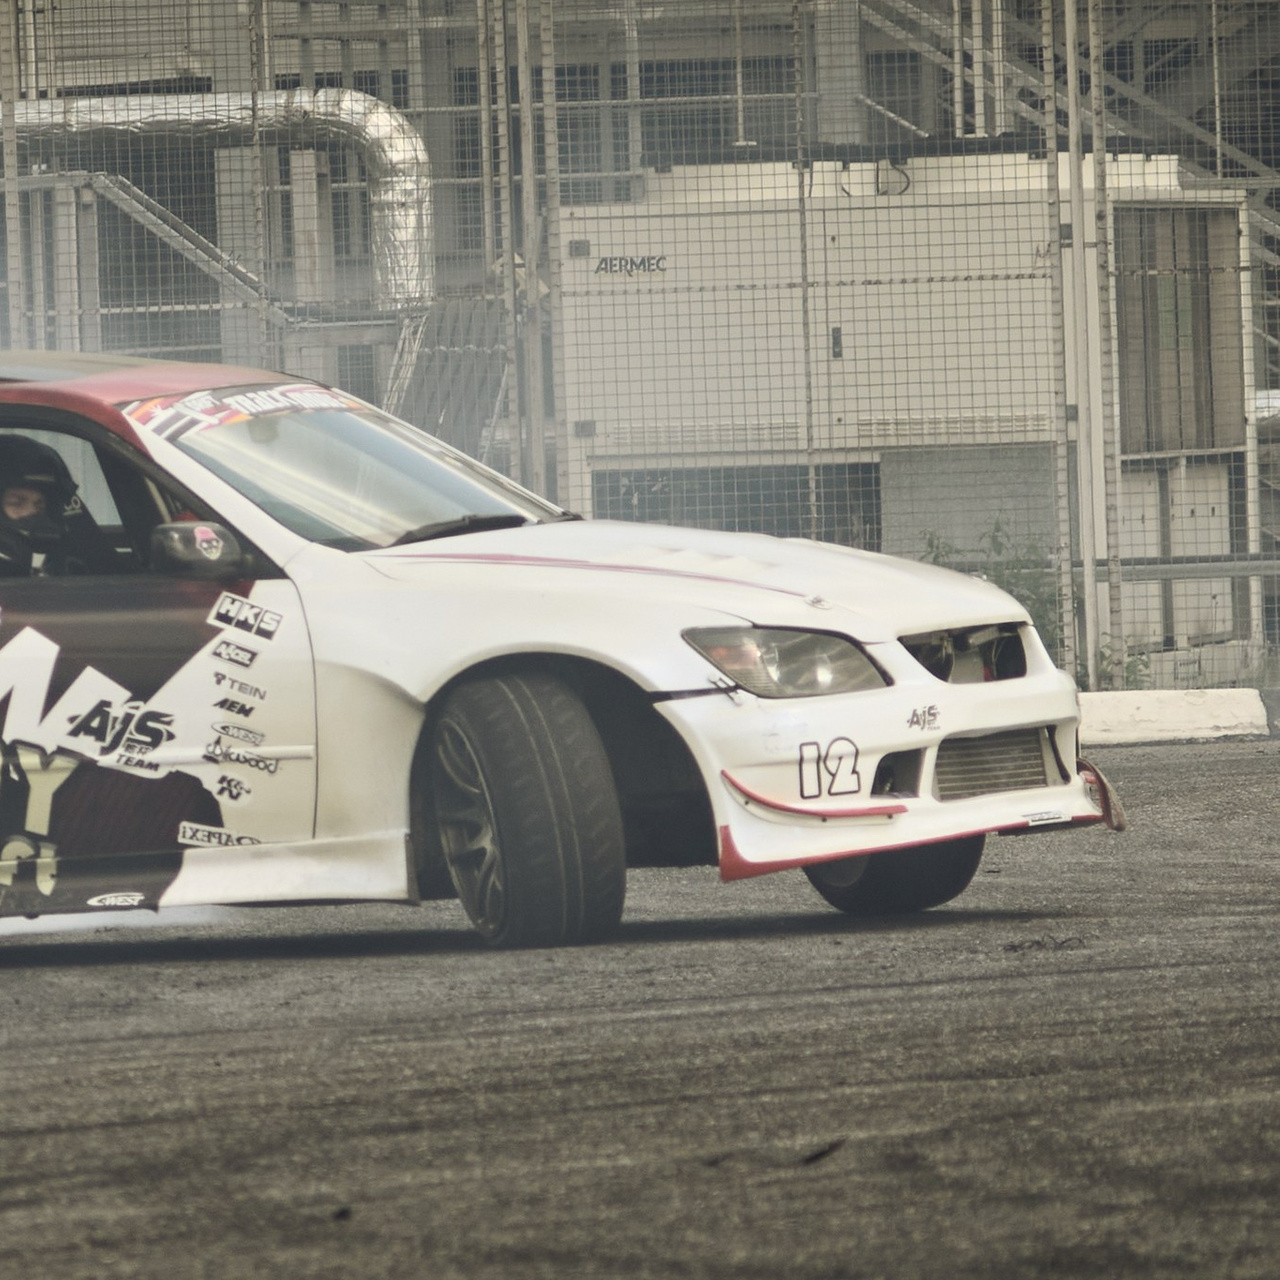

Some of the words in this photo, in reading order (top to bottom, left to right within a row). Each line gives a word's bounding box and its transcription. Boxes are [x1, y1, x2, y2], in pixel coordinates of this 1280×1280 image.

[594, 256, 667, 278] AERMEC
[216, 596, 282, 636] HKS
[227, 677, 268, 701] TEIN
[212, 698, 256, 718] AEM
[116, 754, 161, 773] TEAM
[799, 736, 862, 799] 12
